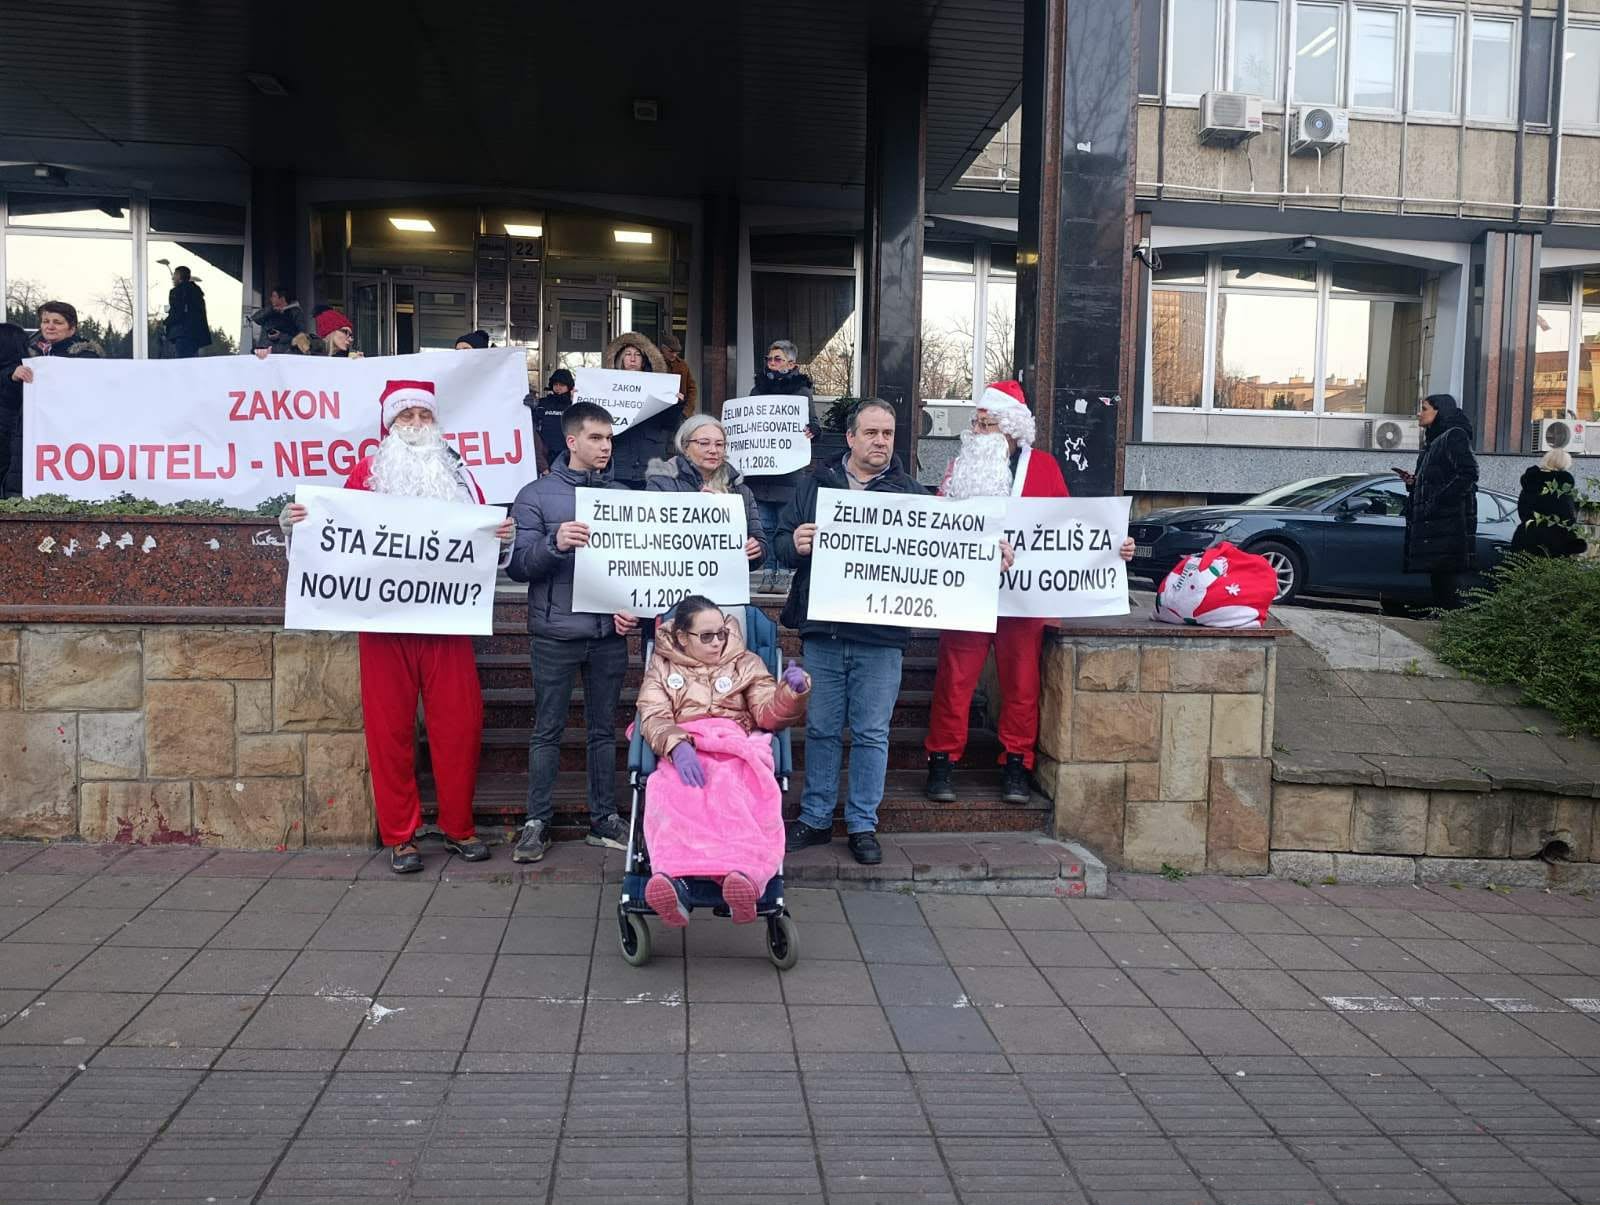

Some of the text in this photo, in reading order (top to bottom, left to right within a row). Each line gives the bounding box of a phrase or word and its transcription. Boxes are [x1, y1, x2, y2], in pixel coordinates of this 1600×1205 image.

[516, 242, 533, 256] 22
[612, 383, 642, 393] ZAKON
[228, 390, 340, 421] ZAKON
[743, 406, 755, 417] DA
[756, 405, 768, 416] SE
[769, 404, 800, 416] ZAKON
[611, 416, 629, 426] ZA
[730, 438, 792, 452] PRIMENJUJE OD
[36, 443, 236, 481] RODITELJ
[251, 460, 263, 469] -
[739, 456, 778, 469] 1.1.2026.
[593, 499, 731, 524] ŽELIM DA SE ZAKON
[833, 500, 985, 532] ŽELIM DA SE ZAKON
[320, 518, 475, 563] ŠTA ŽELIŠ ZA
[818, 532, 996, 561] RODITELJ-NEGOVATELJ
[1003, 523, 1112, 551] TA ŽELIŠ ZA
[608, 560, 719, 577] PRIMENJUJE OD
[843, 562, 965, 588] PRIMENJUJE OD
[999, 567, 1117, 591] VU GODINU?
[300, 571, 482, 606] NOVU GODINU?
[866, 593, 938, 618] 1.1.2026.
